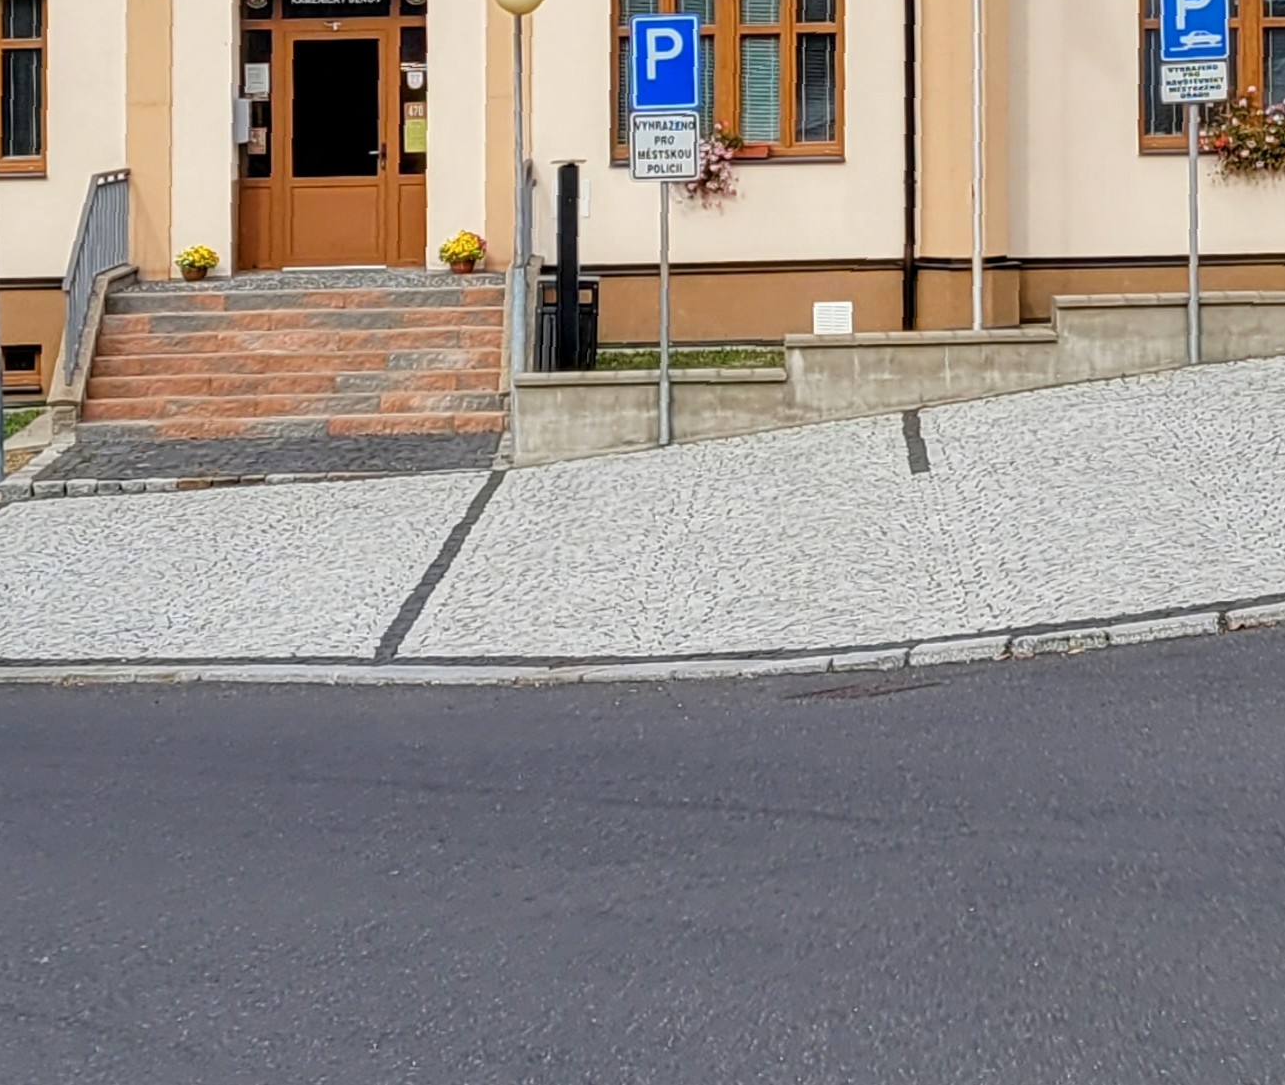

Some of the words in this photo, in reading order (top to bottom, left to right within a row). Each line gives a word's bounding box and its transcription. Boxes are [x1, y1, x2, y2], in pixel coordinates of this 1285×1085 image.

[646, 27, 683, 80] P
[407, 104, 424, 117] 470
[634, 120, 696, 132] VYHRAZENO
[654, 135, 675, 146] PRO
[646, 163, 683, 174] POLICII
